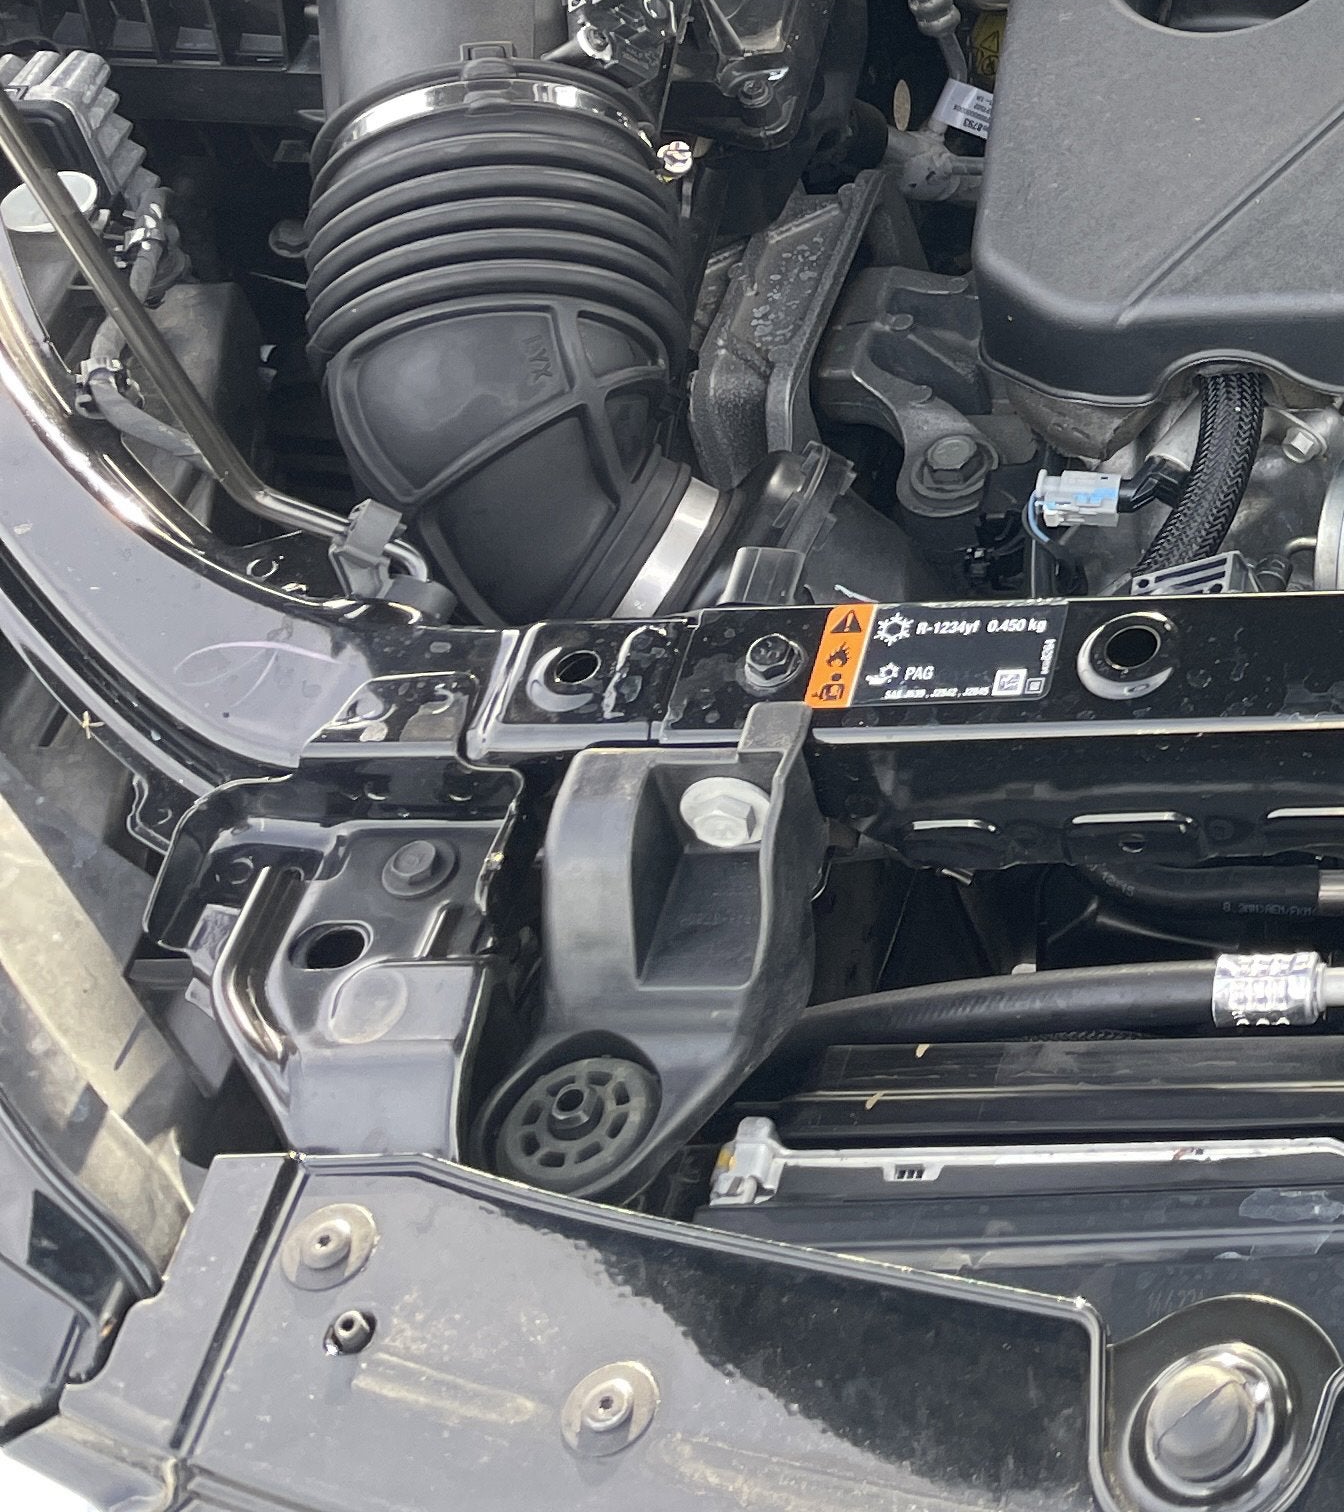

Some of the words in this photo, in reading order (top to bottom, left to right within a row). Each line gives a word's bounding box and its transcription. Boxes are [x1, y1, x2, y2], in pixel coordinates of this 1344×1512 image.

[916, 619, 980, 636] R-1234yf
[987, 619, 1026, 633] 0.450
[1027, 618, 1048, 634] kg
[904, 665, 935, 681] PAG
